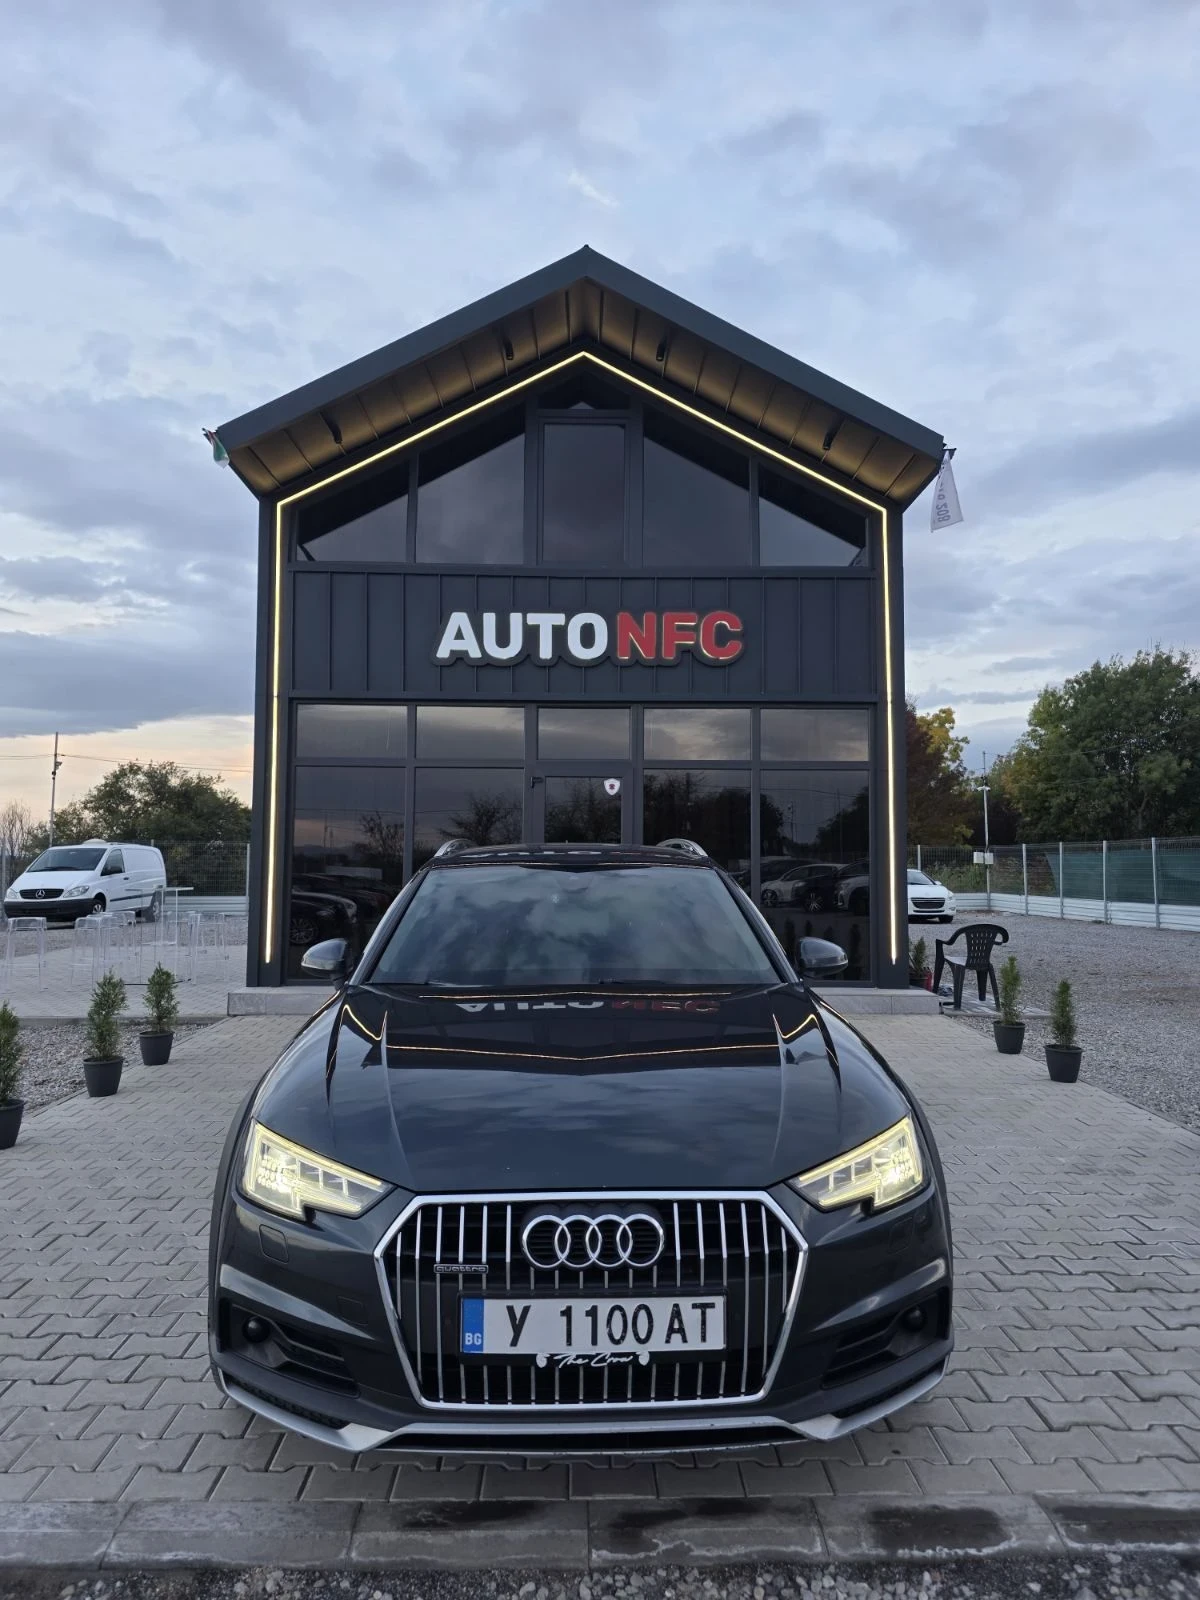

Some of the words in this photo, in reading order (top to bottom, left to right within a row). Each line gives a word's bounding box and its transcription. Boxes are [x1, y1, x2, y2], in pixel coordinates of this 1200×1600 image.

[464, 1332, 482, 1346] BG
[559, 1303, 655, 1347] 1100
[664, 1302, 716, 1344] AT
